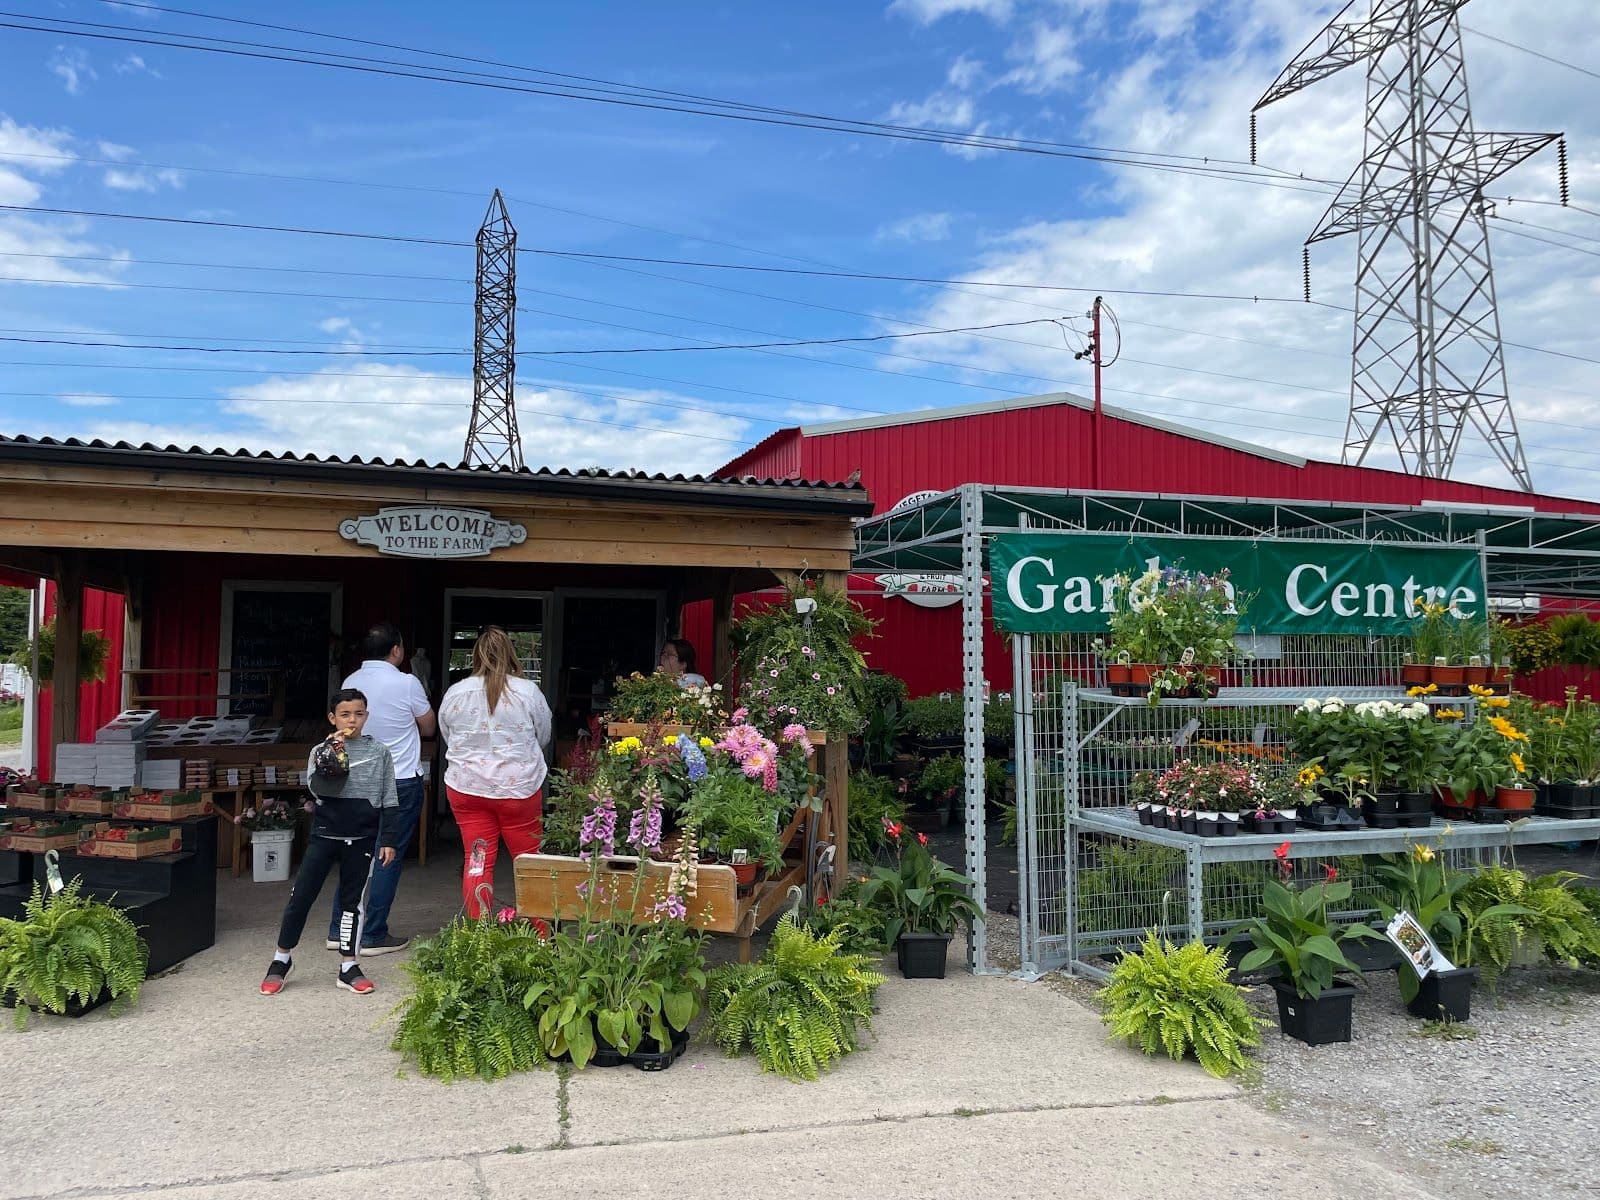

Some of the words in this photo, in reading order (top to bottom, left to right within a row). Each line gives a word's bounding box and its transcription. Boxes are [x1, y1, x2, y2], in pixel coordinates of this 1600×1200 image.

[375, 514, 497, 538] WELCOME
[385, 536, 405, 548] TO
[408, 536, 439, 549] THE
[443, 537, 485, 550] FARM
[1285, 563, 1477, 620] Centre
[340, 910, 354, 951] PUMA
